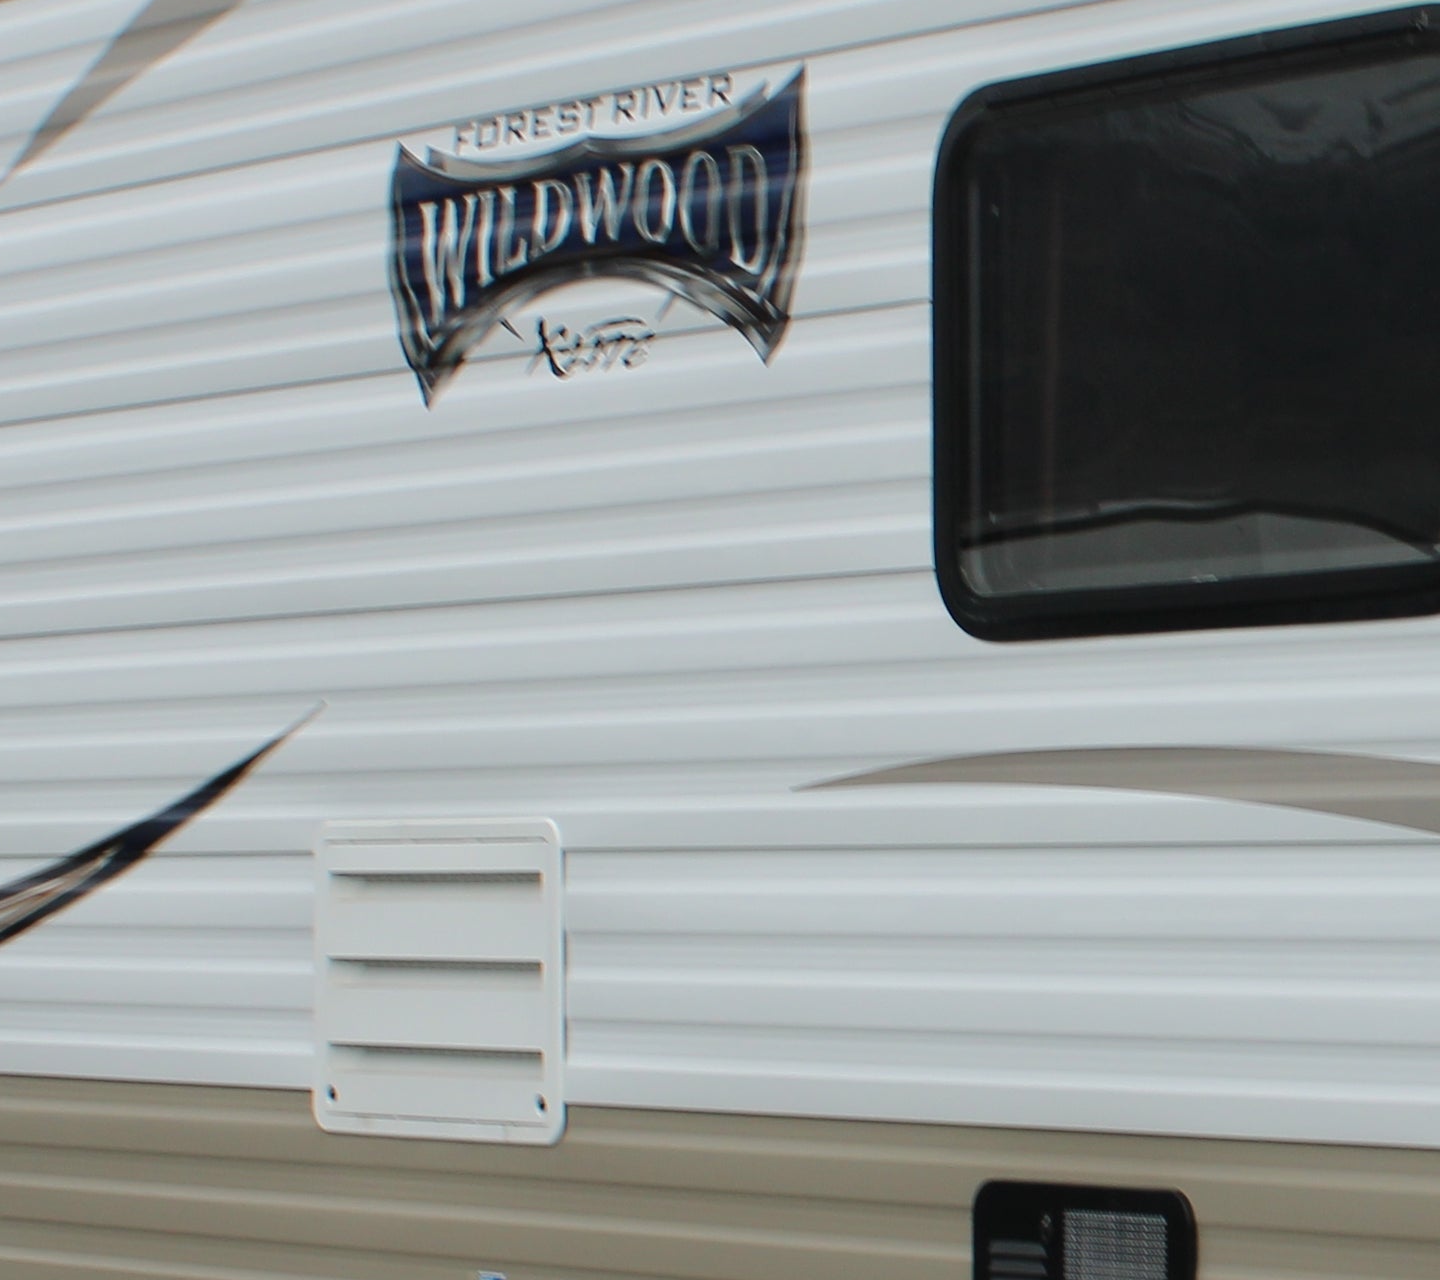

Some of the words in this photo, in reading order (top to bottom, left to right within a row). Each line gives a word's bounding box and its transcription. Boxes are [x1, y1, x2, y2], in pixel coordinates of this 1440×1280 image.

[456, 97, 604, 152] FOREST
[610, 73, 734, 125] RIVER
[419, 143, 770, 324] WILDWOOD
